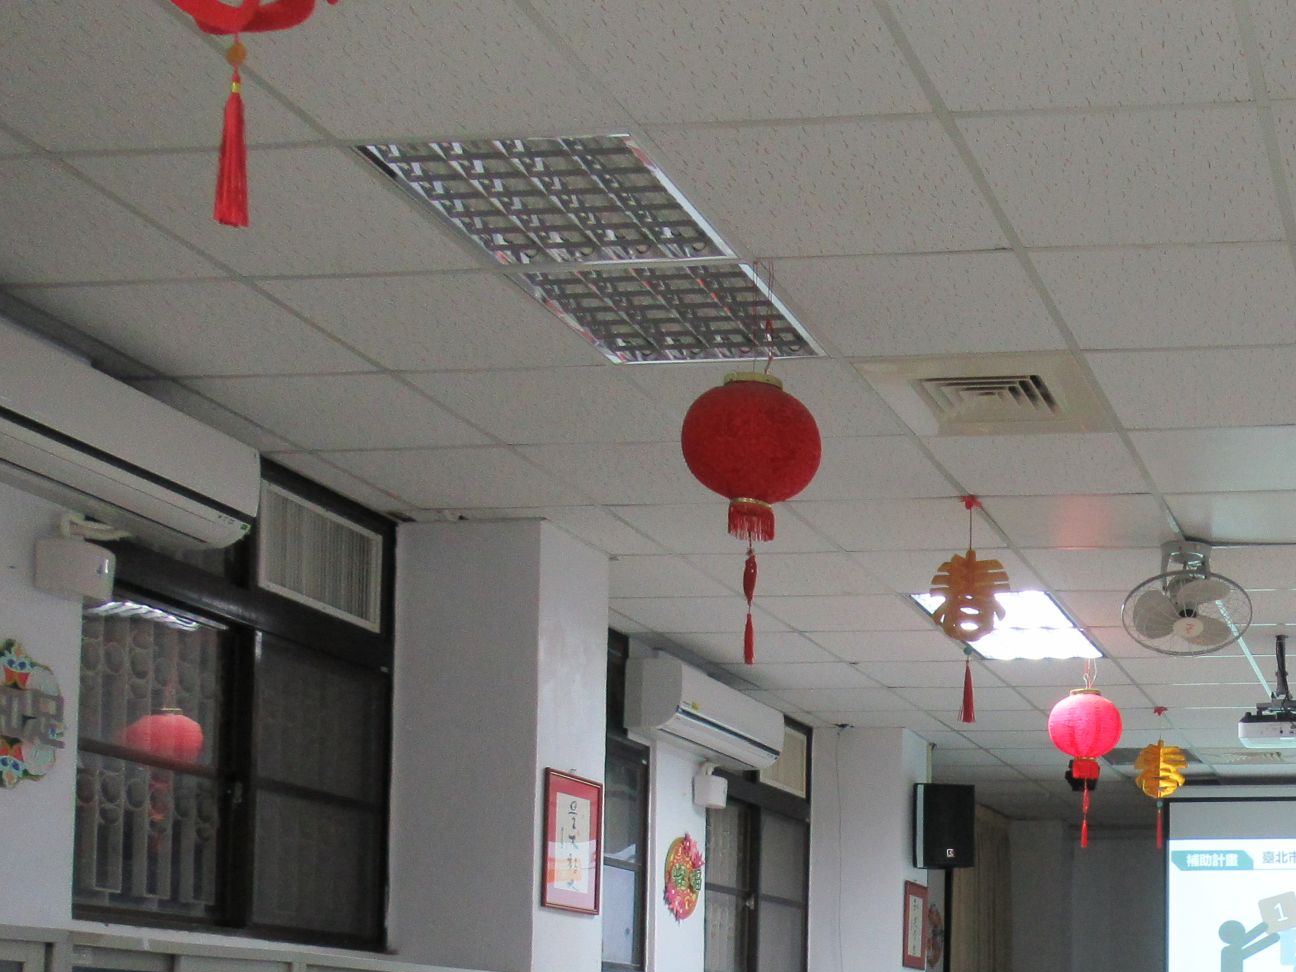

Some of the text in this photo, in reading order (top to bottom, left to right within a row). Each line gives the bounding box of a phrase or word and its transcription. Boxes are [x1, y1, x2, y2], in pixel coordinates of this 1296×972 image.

[1186, 853, 1239, 868] 補助計畫
[1273, 902, 1289, 923] 1
